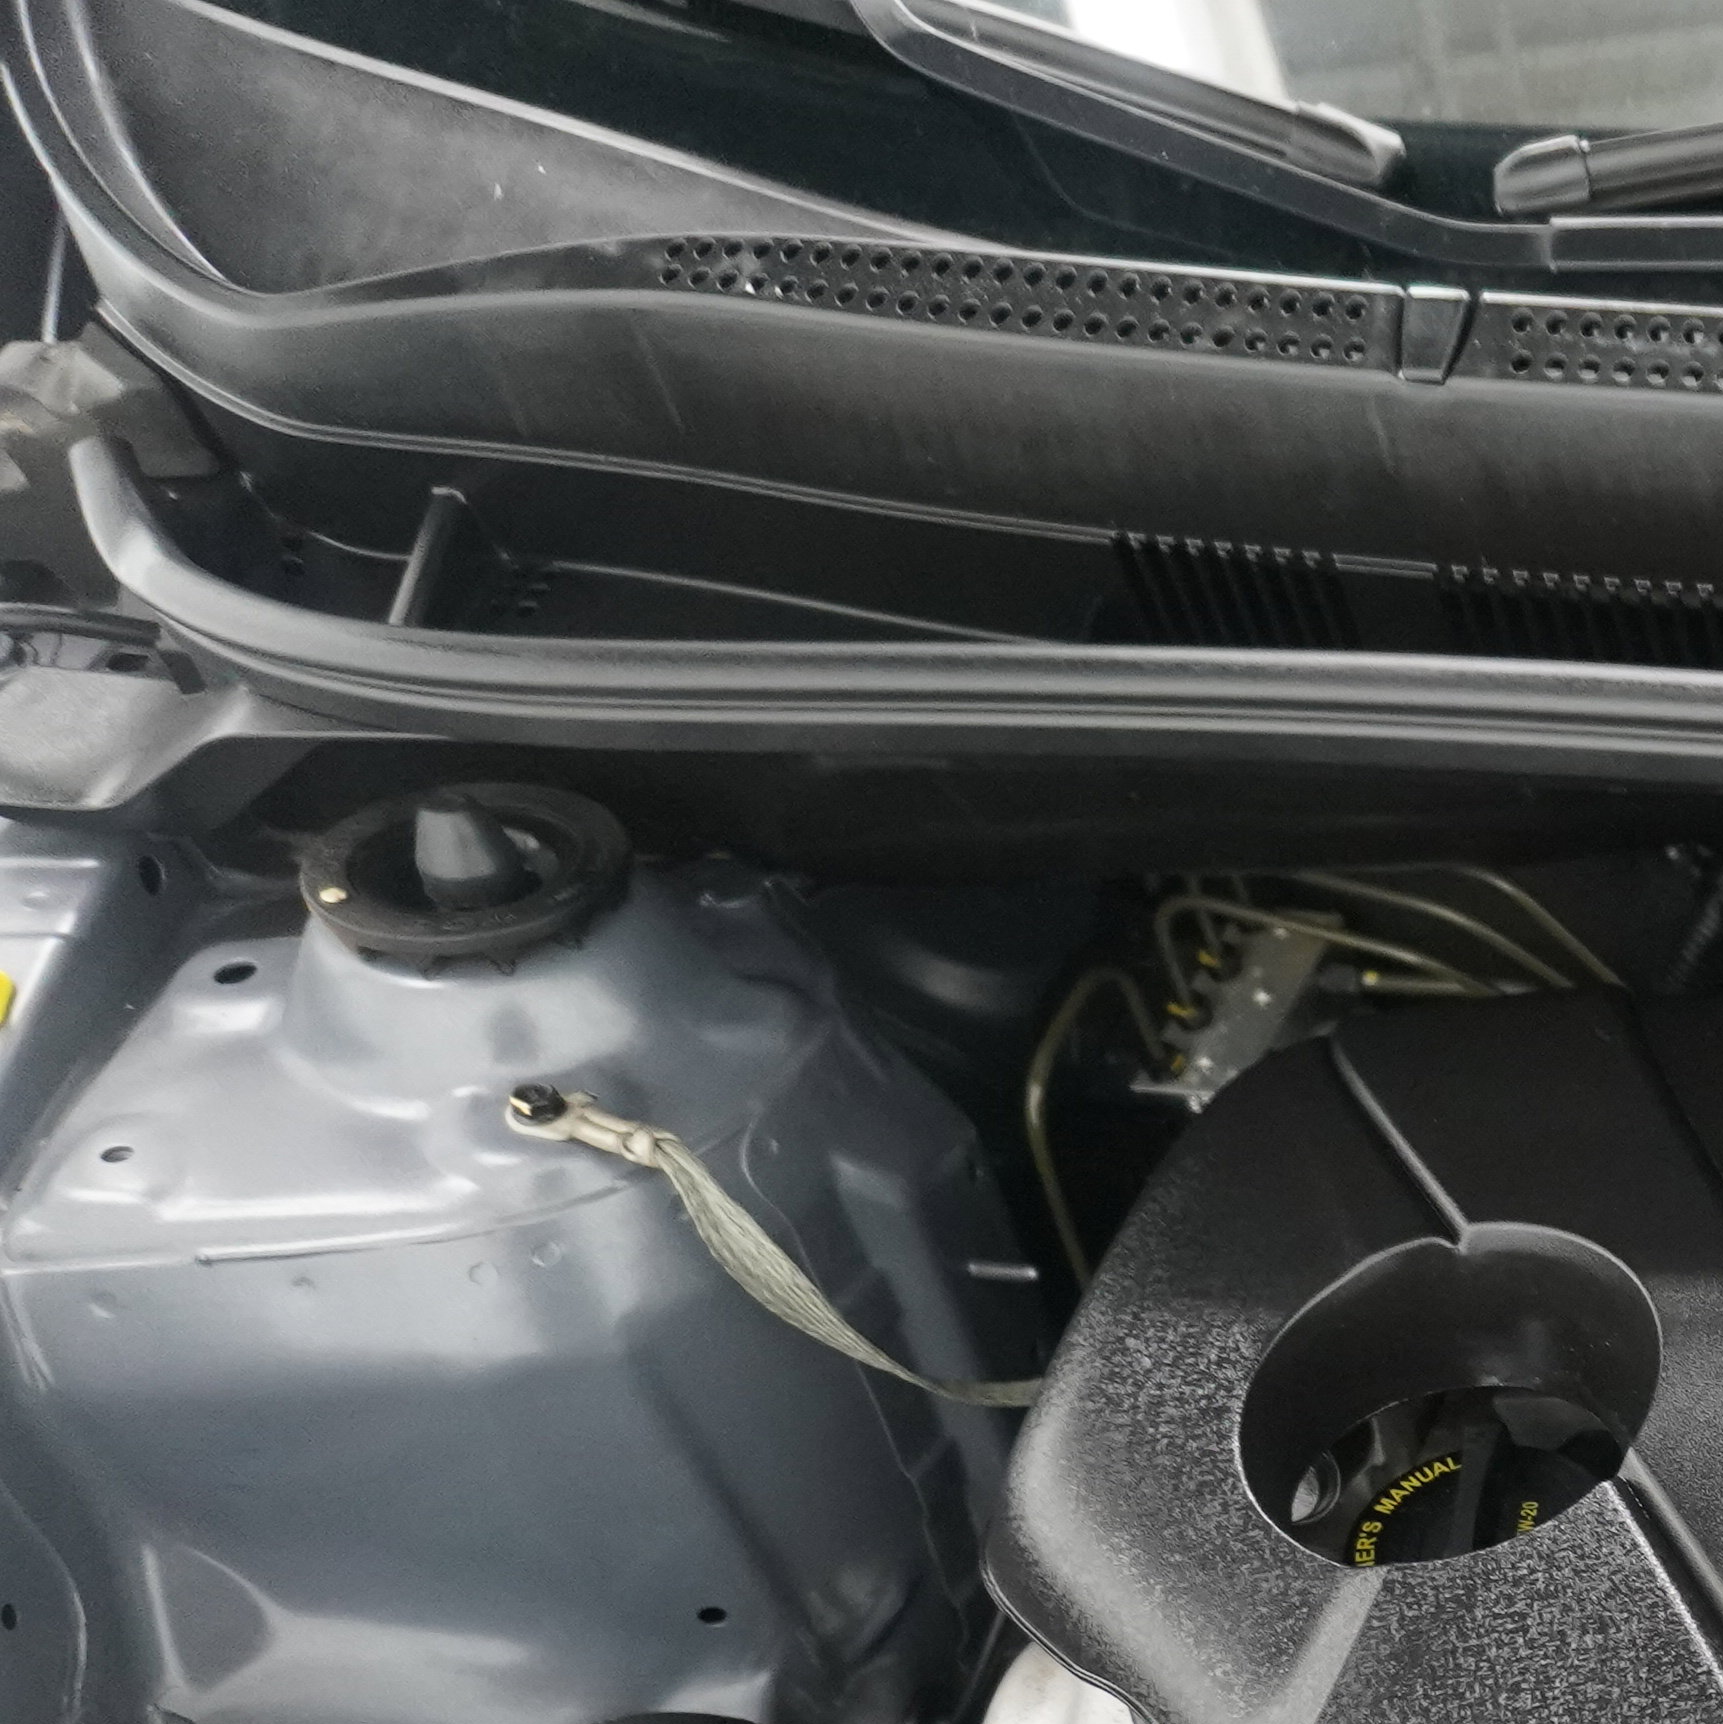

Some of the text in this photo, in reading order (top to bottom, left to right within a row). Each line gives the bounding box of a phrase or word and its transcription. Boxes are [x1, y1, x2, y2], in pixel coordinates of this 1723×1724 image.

[1354, 1456, 1463, 1567] ER'S MANUAL
[1516, 1501, 1539, 1537] W-20
